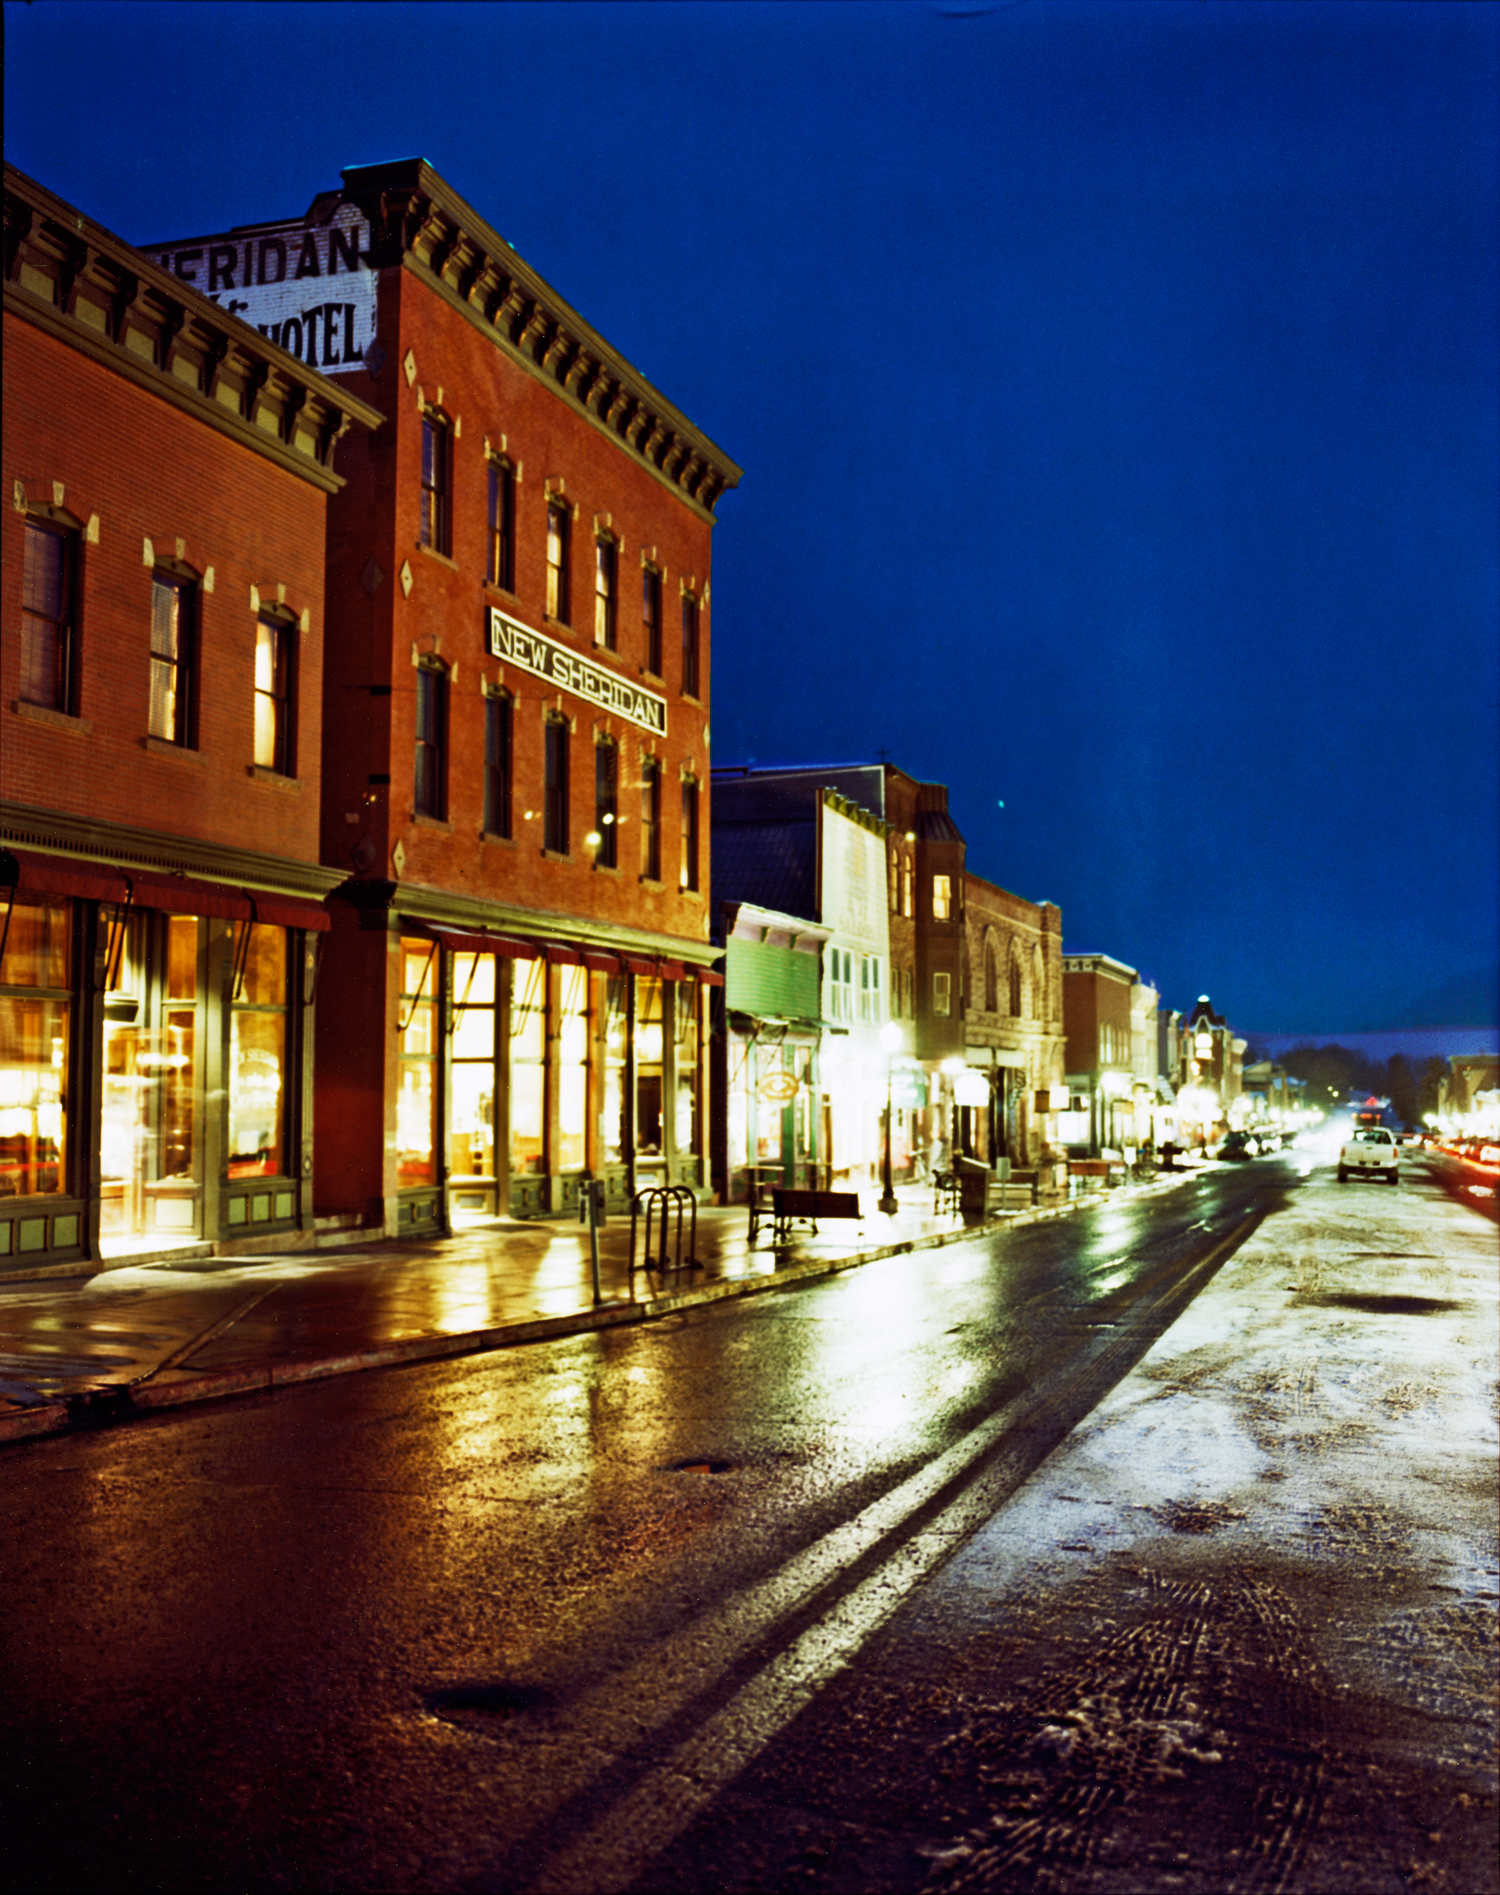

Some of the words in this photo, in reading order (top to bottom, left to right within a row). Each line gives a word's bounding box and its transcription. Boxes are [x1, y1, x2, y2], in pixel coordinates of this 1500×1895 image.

[161, 225, 360, 292] ERIDAN
[494, 619, 547, 671] NEW
[552, 651, 660, 728] SHERIDAN
